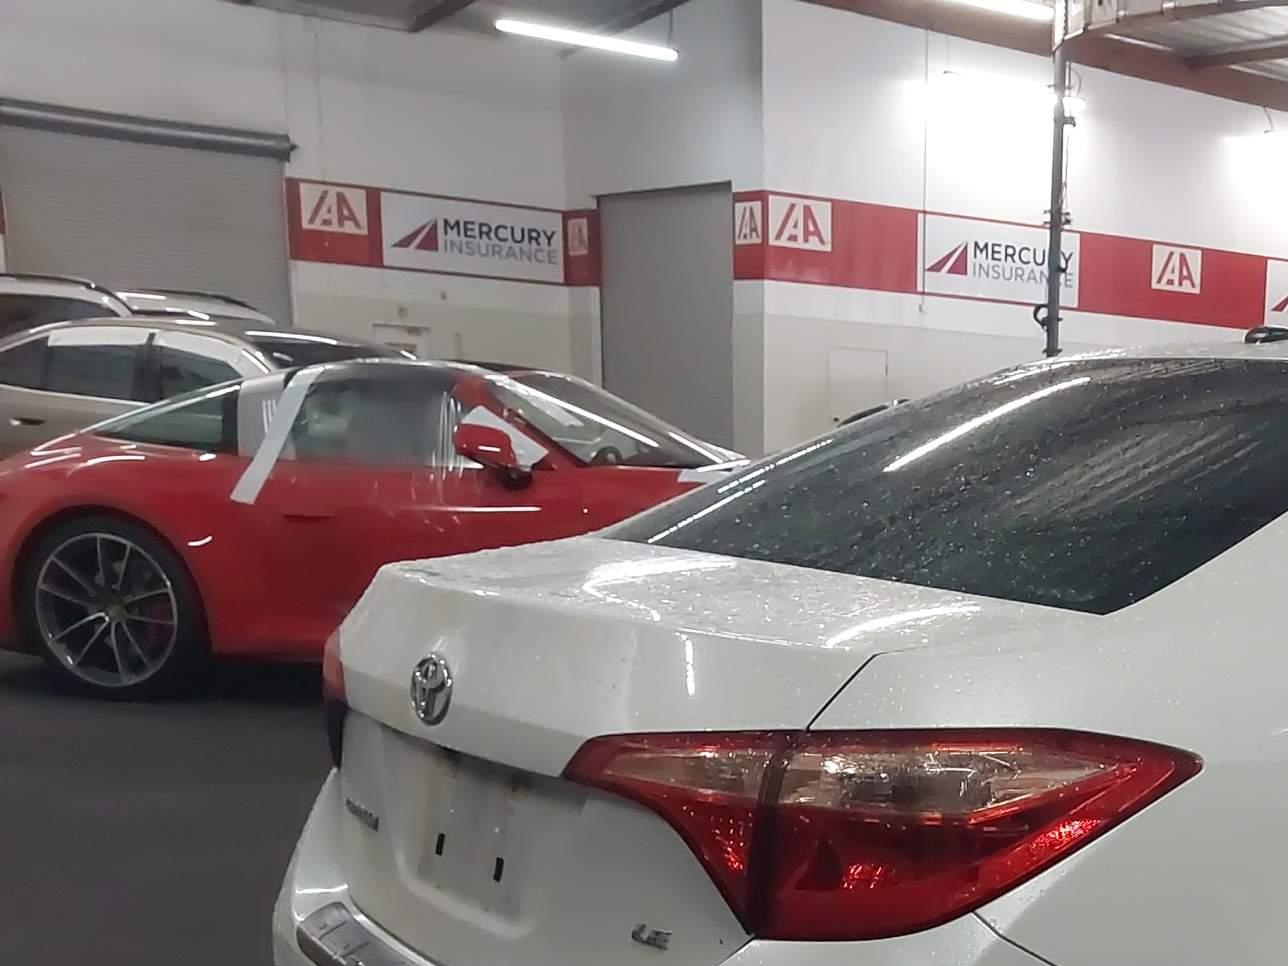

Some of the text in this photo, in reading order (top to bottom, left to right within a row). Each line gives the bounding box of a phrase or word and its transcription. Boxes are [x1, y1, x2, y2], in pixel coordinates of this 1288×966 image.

[443, 217, 556, 248] MERCURY
[443, 239, 558, 265] INSURANCE
[973, 240, 1074, 272] MERCUY
[972, 261, 1074, 289] INSURANE
